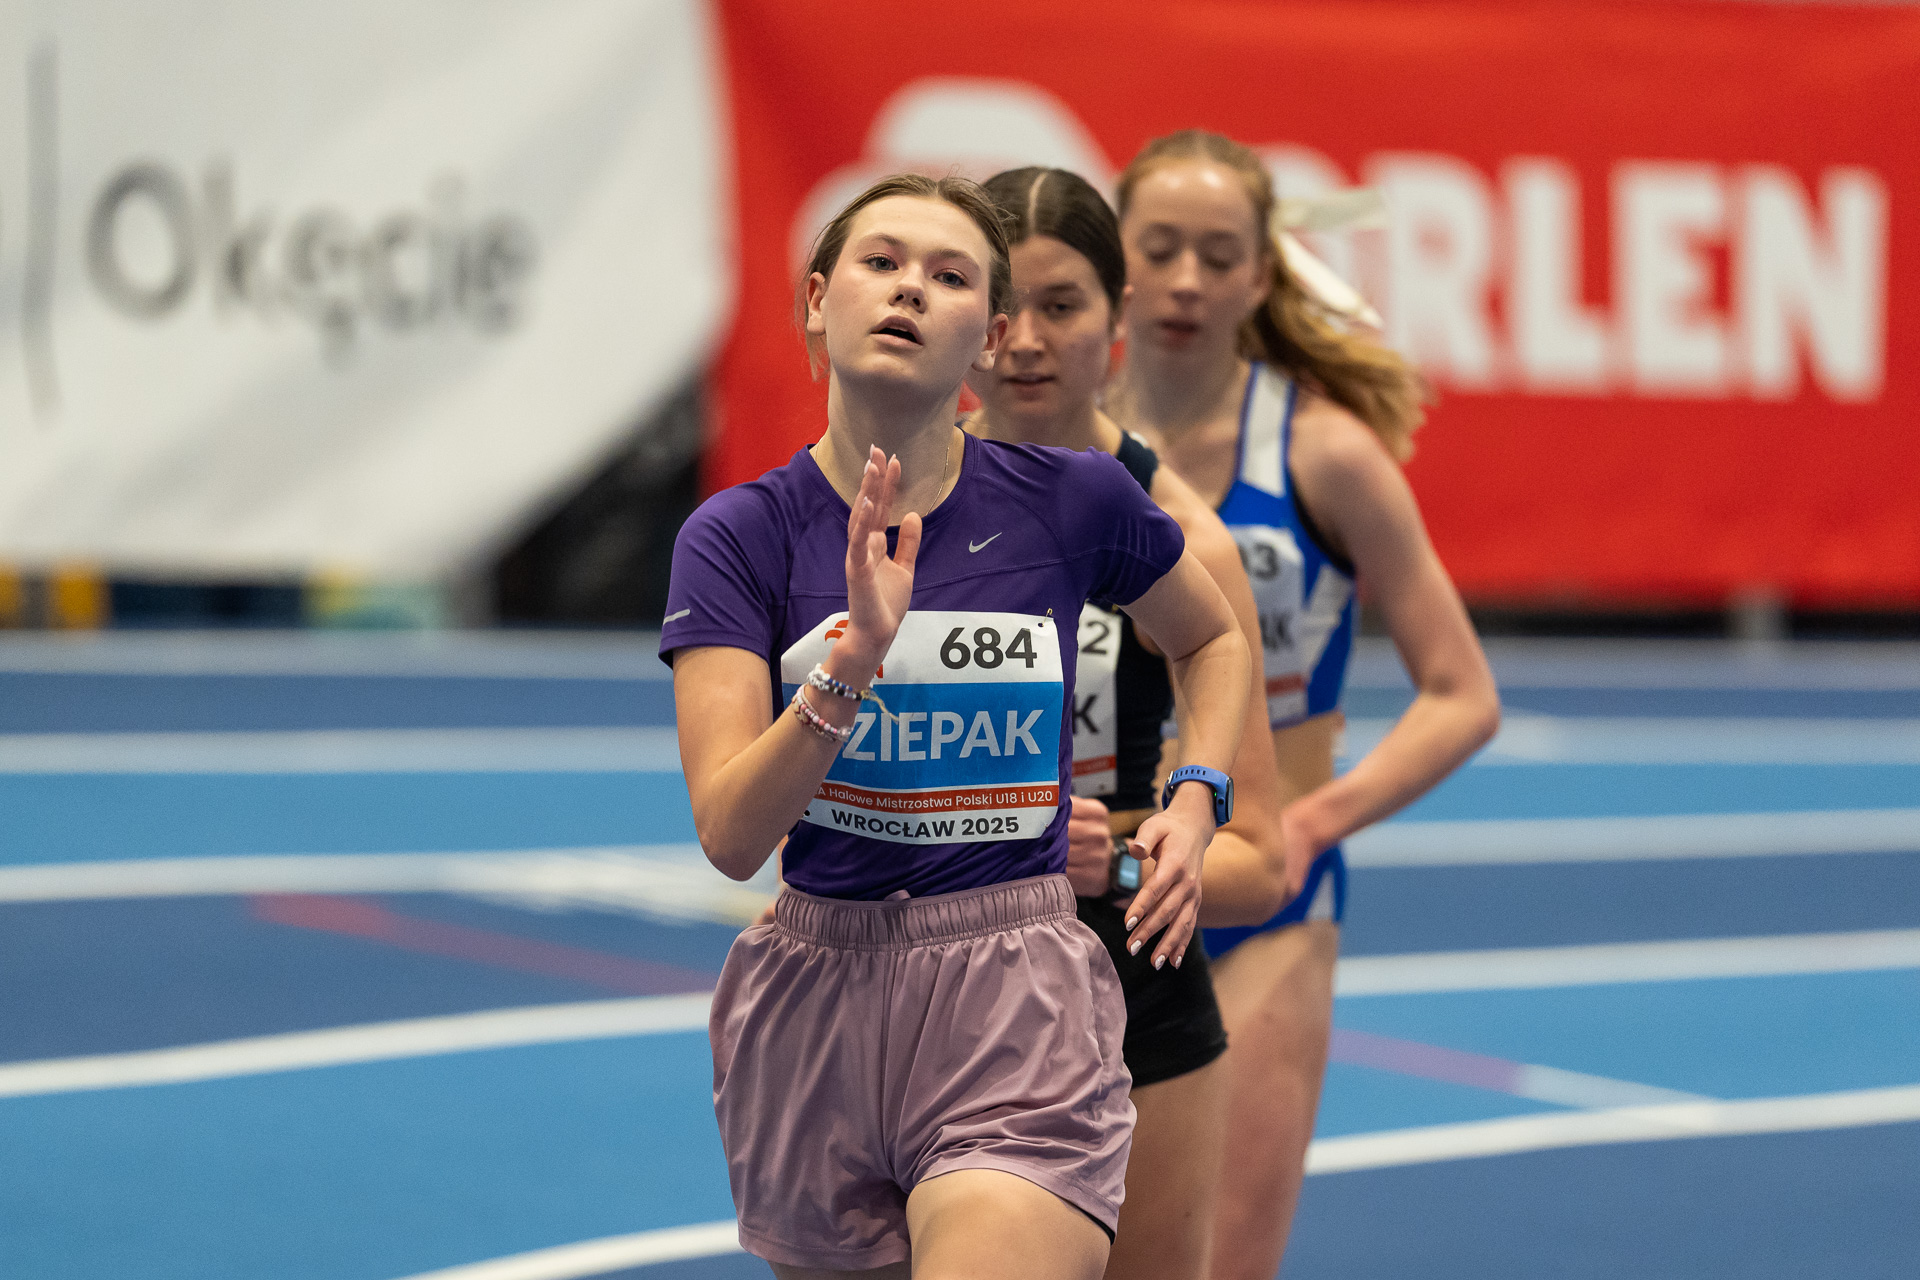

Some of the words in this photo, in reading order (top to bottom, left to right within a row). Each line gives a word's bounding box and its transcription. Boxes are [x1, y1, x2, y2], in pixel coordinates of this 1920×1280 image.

[940, 627, 1038, 670] 684
[829, 787, 873, 806] Halowe
[876, 796, 953, 810] Mistrzostwa
[955, 793, 993, 807] Polski
[995, 792, 1018, 805] U18
[1021, 791, 1025, 803] i
[1028, 790, 1053, 803] U20
[831, 809, 956, 838] WROCŁAW
[961, 816, 1019, 836] 2025
